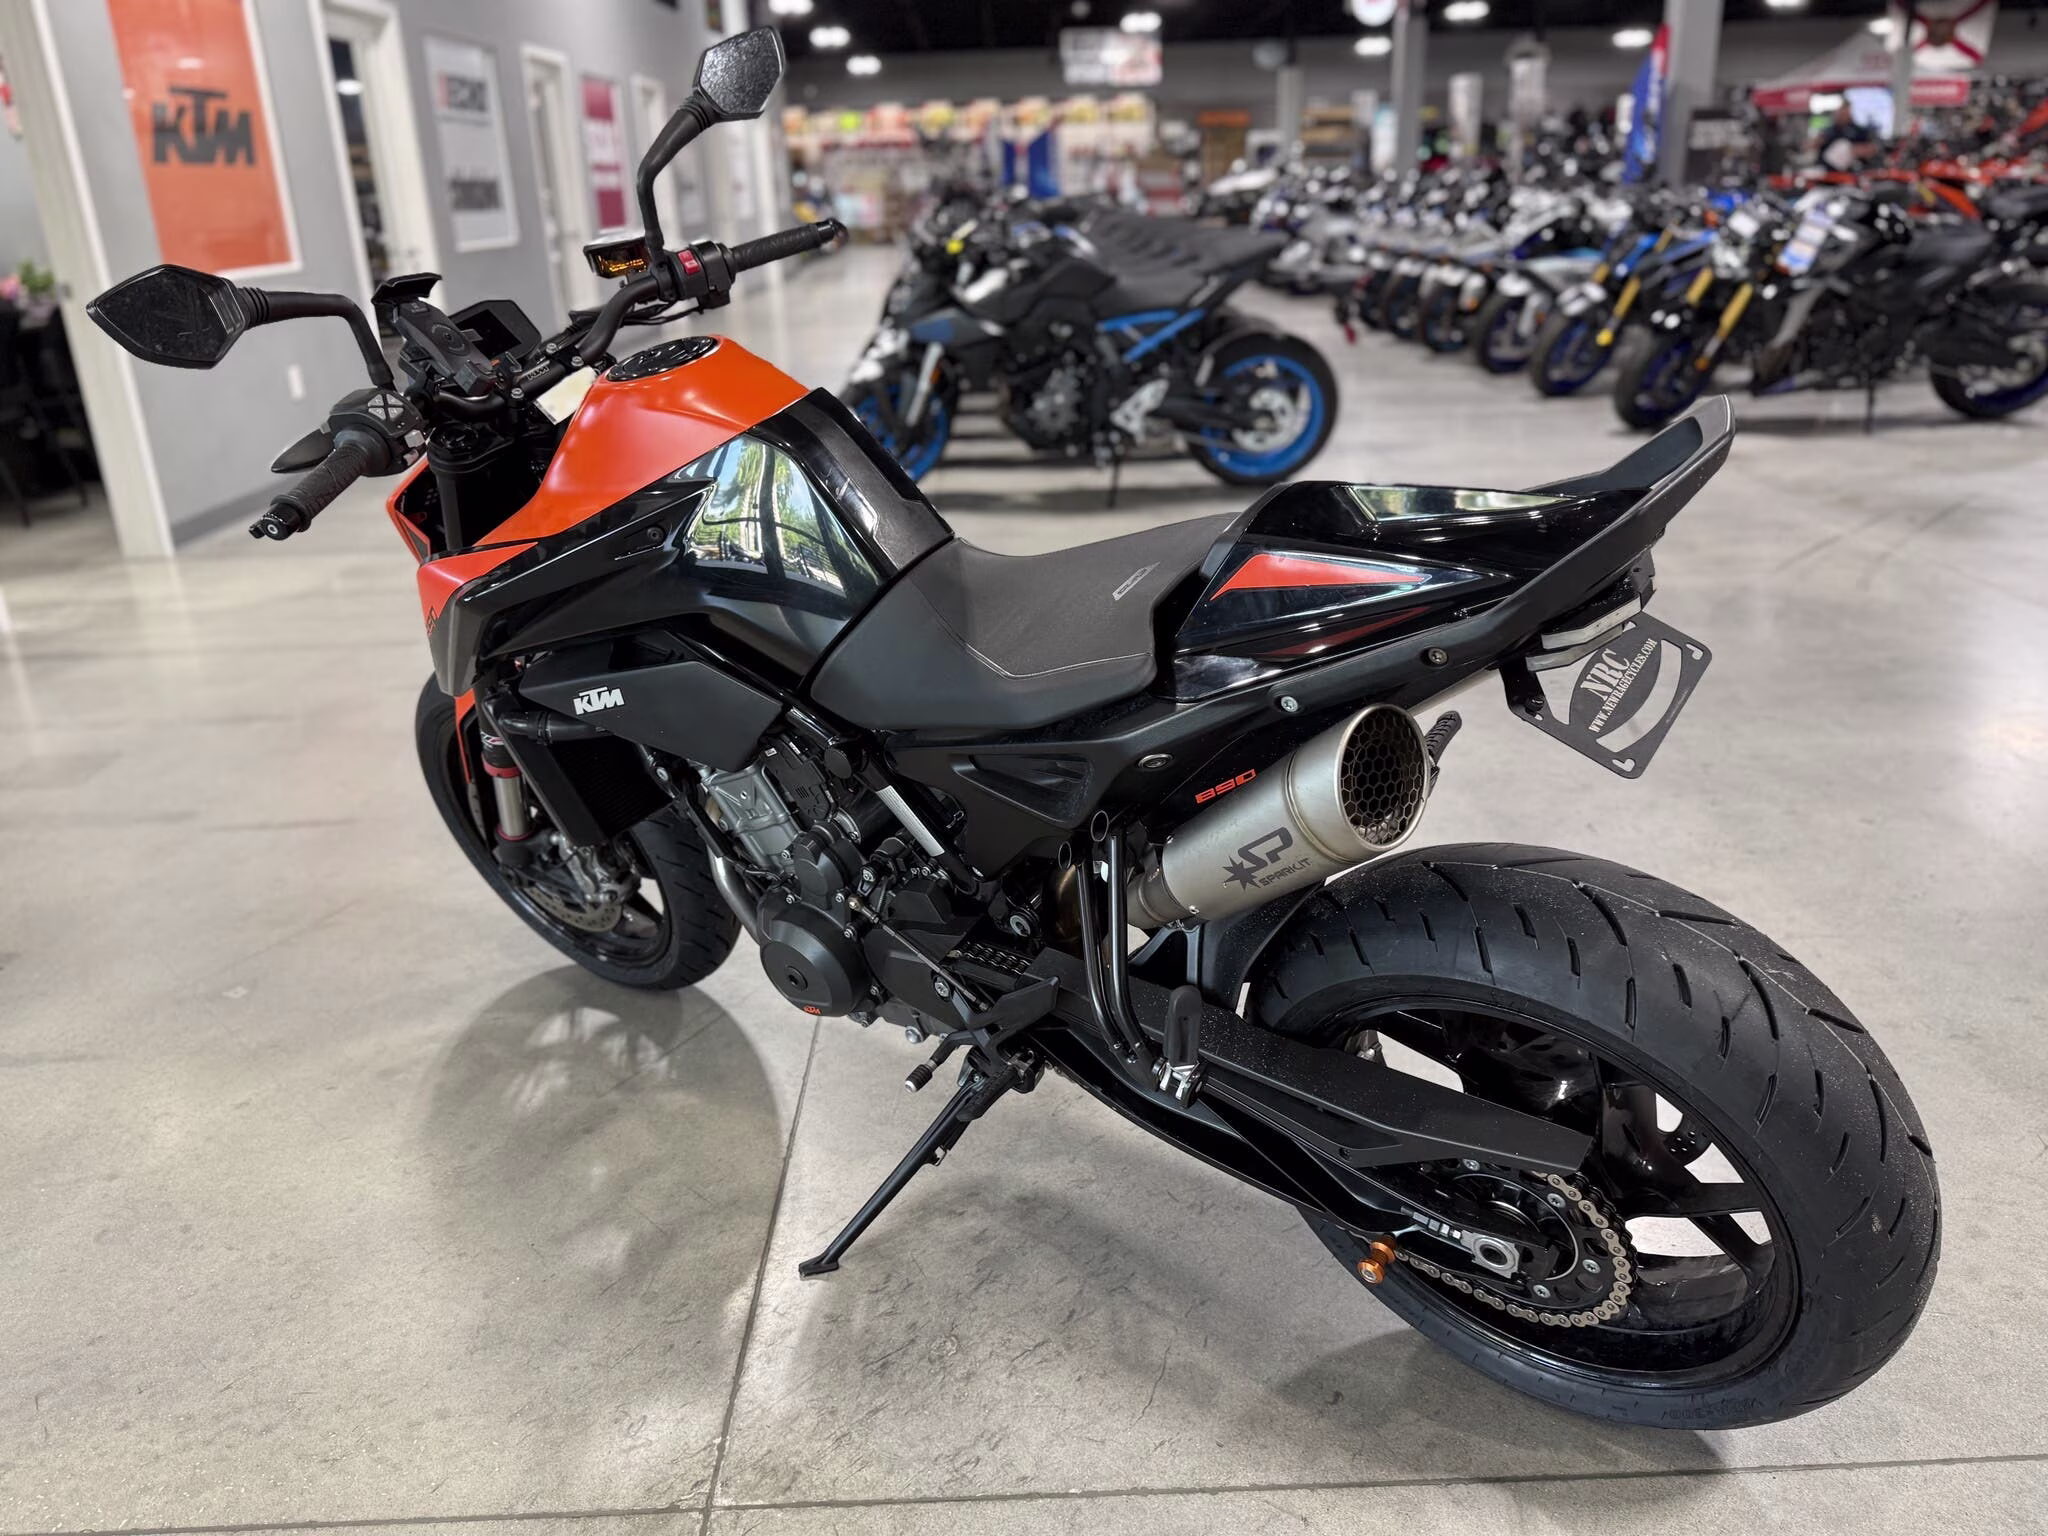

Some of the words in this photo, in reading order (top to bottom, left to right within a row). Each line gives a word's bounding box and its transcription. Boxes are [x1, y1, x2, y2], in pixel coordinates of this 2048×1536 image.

[152, 86, 255, 166] KTM
[573, 686, 625, 715] KTM
[1580, 647, 1631, 702] NRC
[1588, 637, 1658, 733] WWW.NEWRAGECYCLES.COM
[1195, 768, 1257, 804] 890
